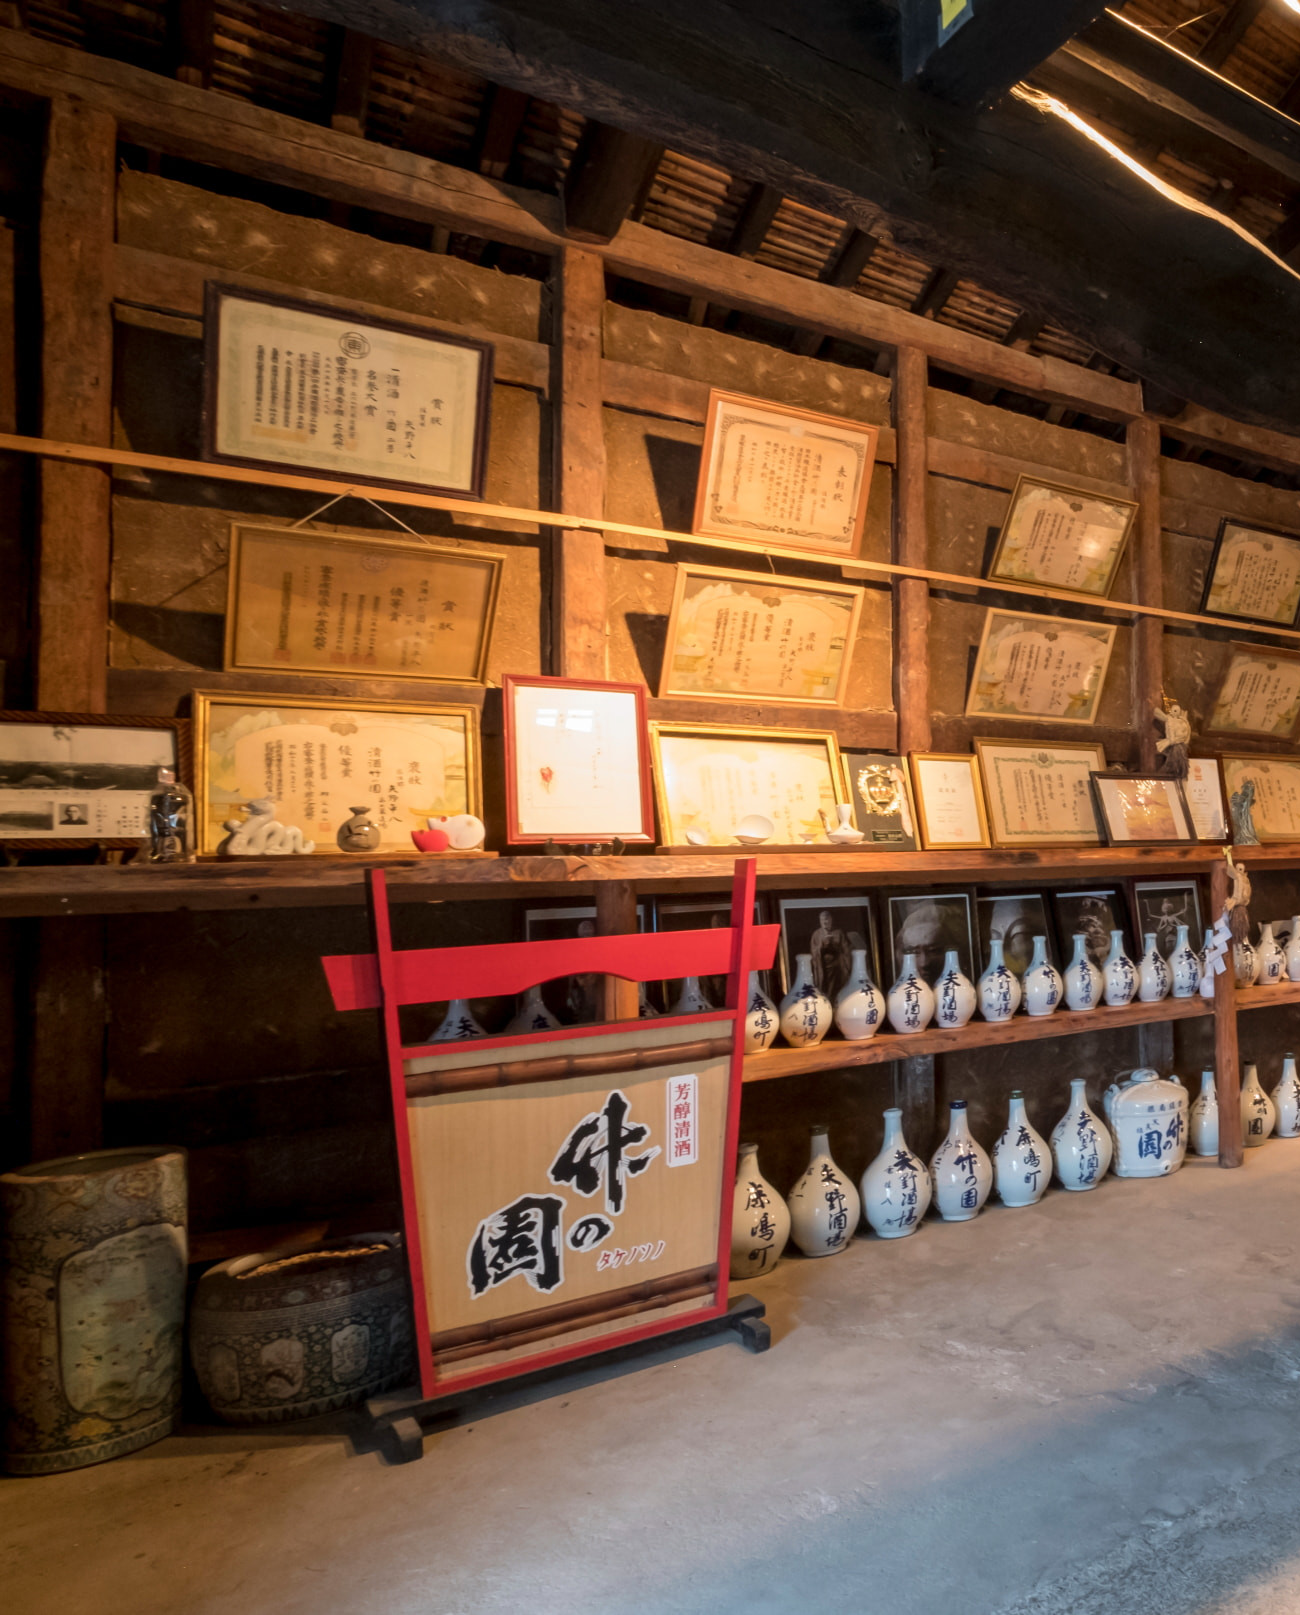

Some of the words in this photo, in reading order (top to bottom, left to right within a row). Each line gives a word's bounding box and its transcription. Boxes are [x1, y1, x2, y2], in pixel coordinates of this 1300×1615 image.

[672, 1083, 691, 1159] 芳醇清酒
[470, 1091, 658, 1296] 竹の園
[598, 1241, 665, 1270] タケノソノ
